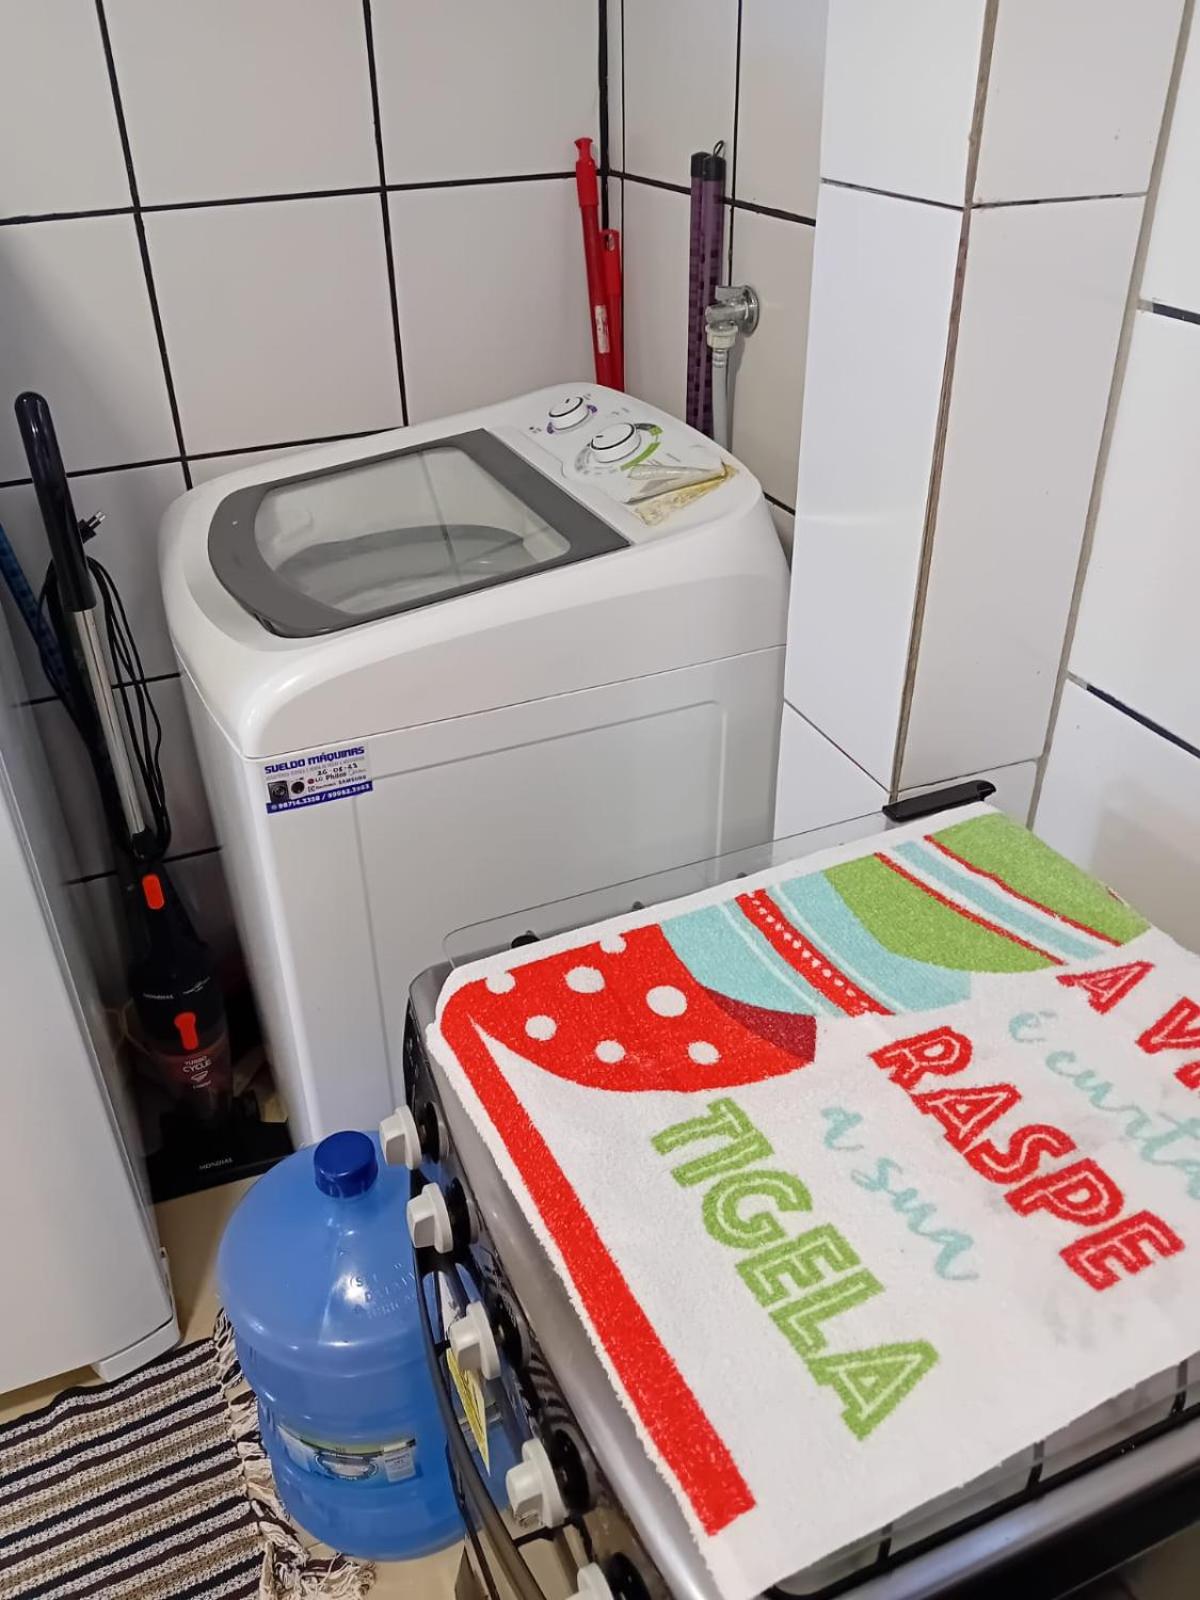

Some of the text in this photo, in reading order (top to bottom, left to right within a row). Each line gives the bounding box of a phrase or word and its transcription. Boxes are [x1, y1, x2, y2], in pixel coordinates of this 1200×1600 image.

[265, 759, 305, 774] SUELDO
[1056, 961, 1155, 1014] A
[869, 1025, 1185, 1291] RASPE
[650, 1097, 940, 1441] TIGELA
